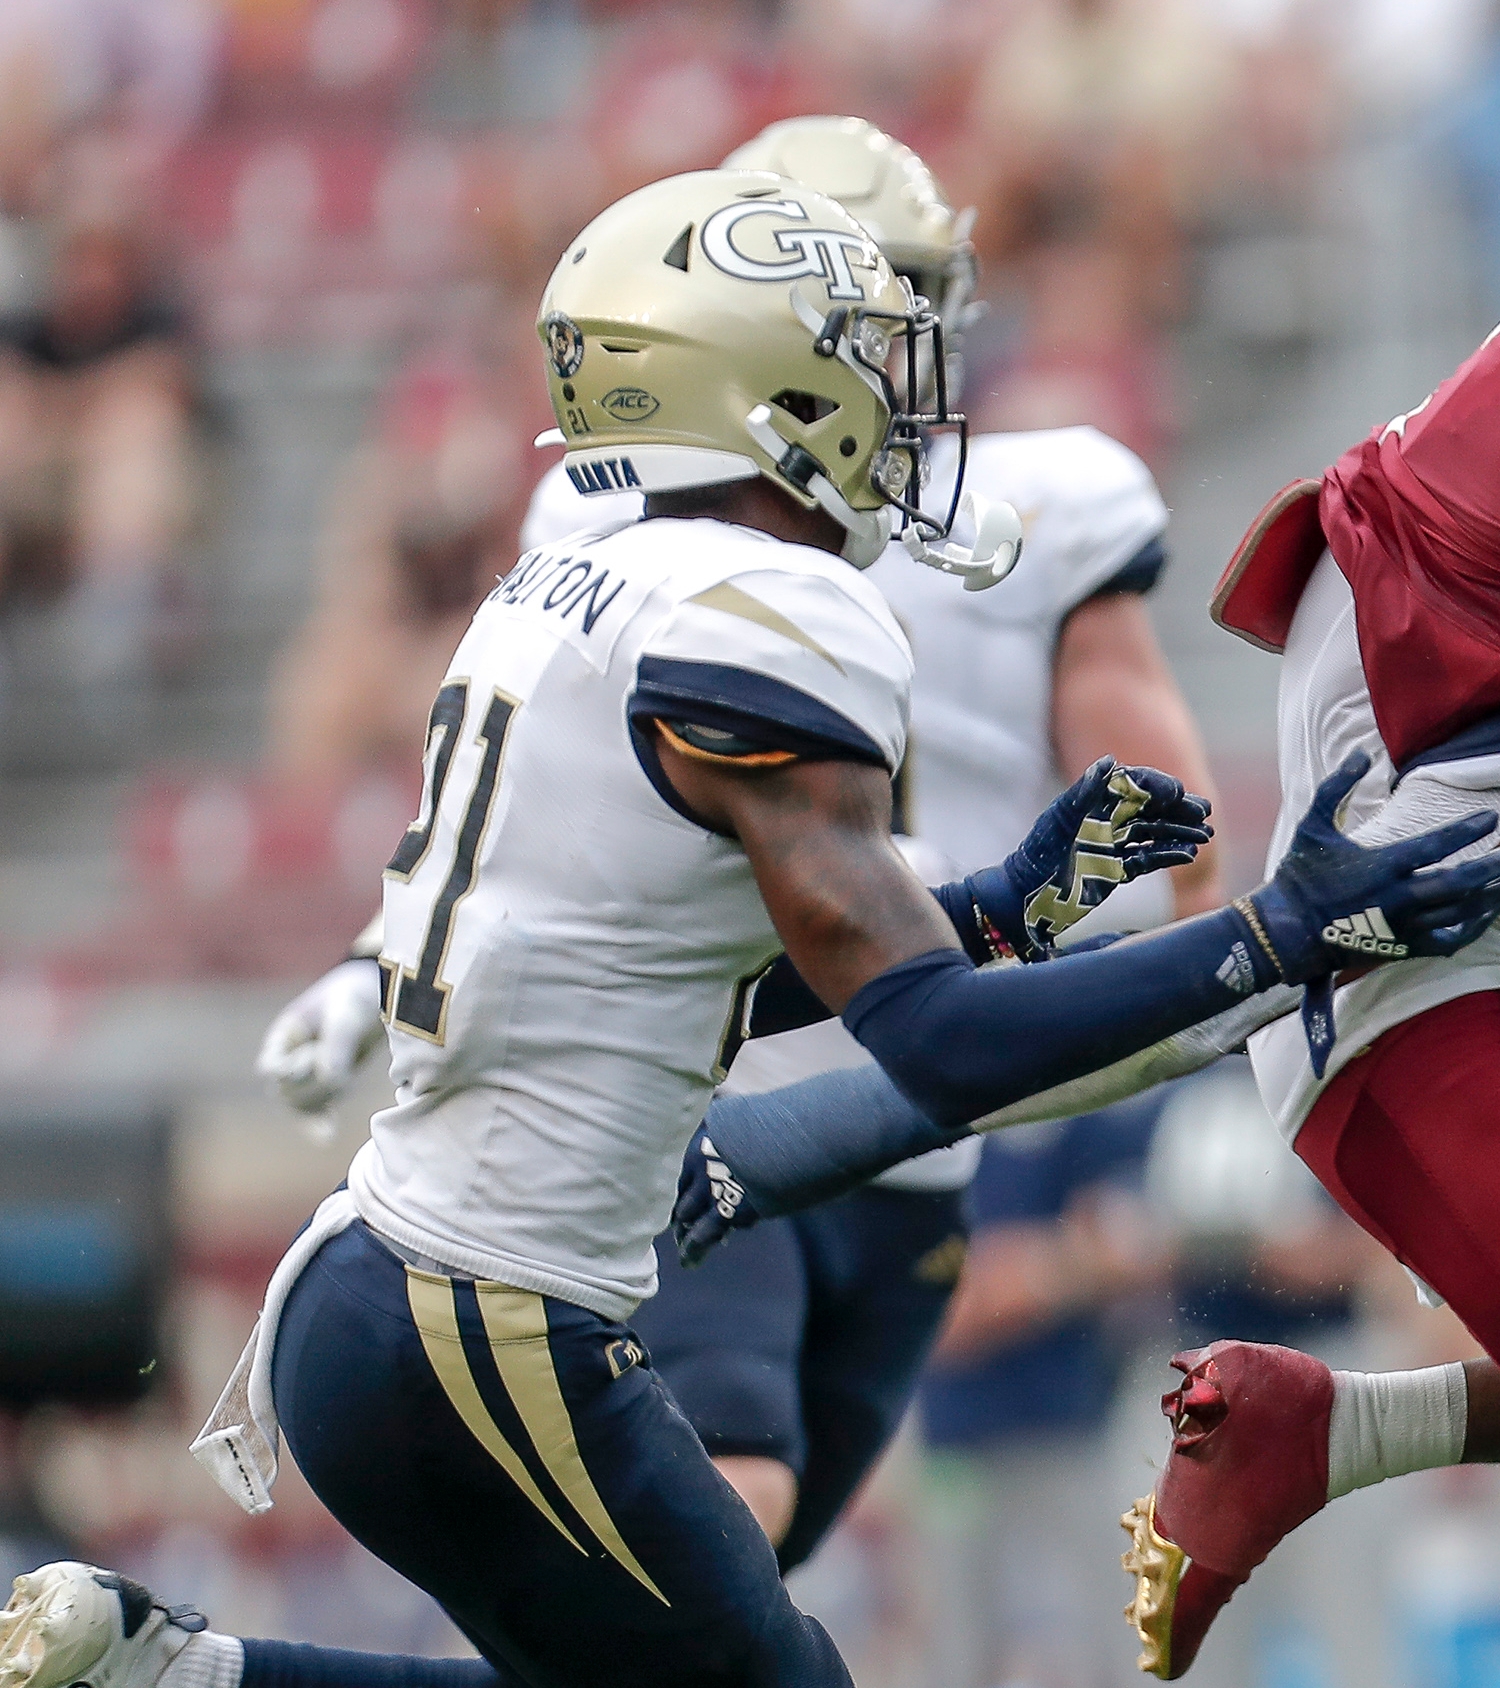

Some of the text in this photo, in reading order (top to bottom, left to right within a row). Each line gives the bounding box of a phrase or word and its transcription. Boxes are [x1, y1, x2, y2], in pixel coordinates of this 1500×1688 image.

[700, 199, 870, 300] GT
[609, 394, 650, 408] ACC
[567, 407, 591, 433] 21
[1321, 926, 1409, 955] adidas
